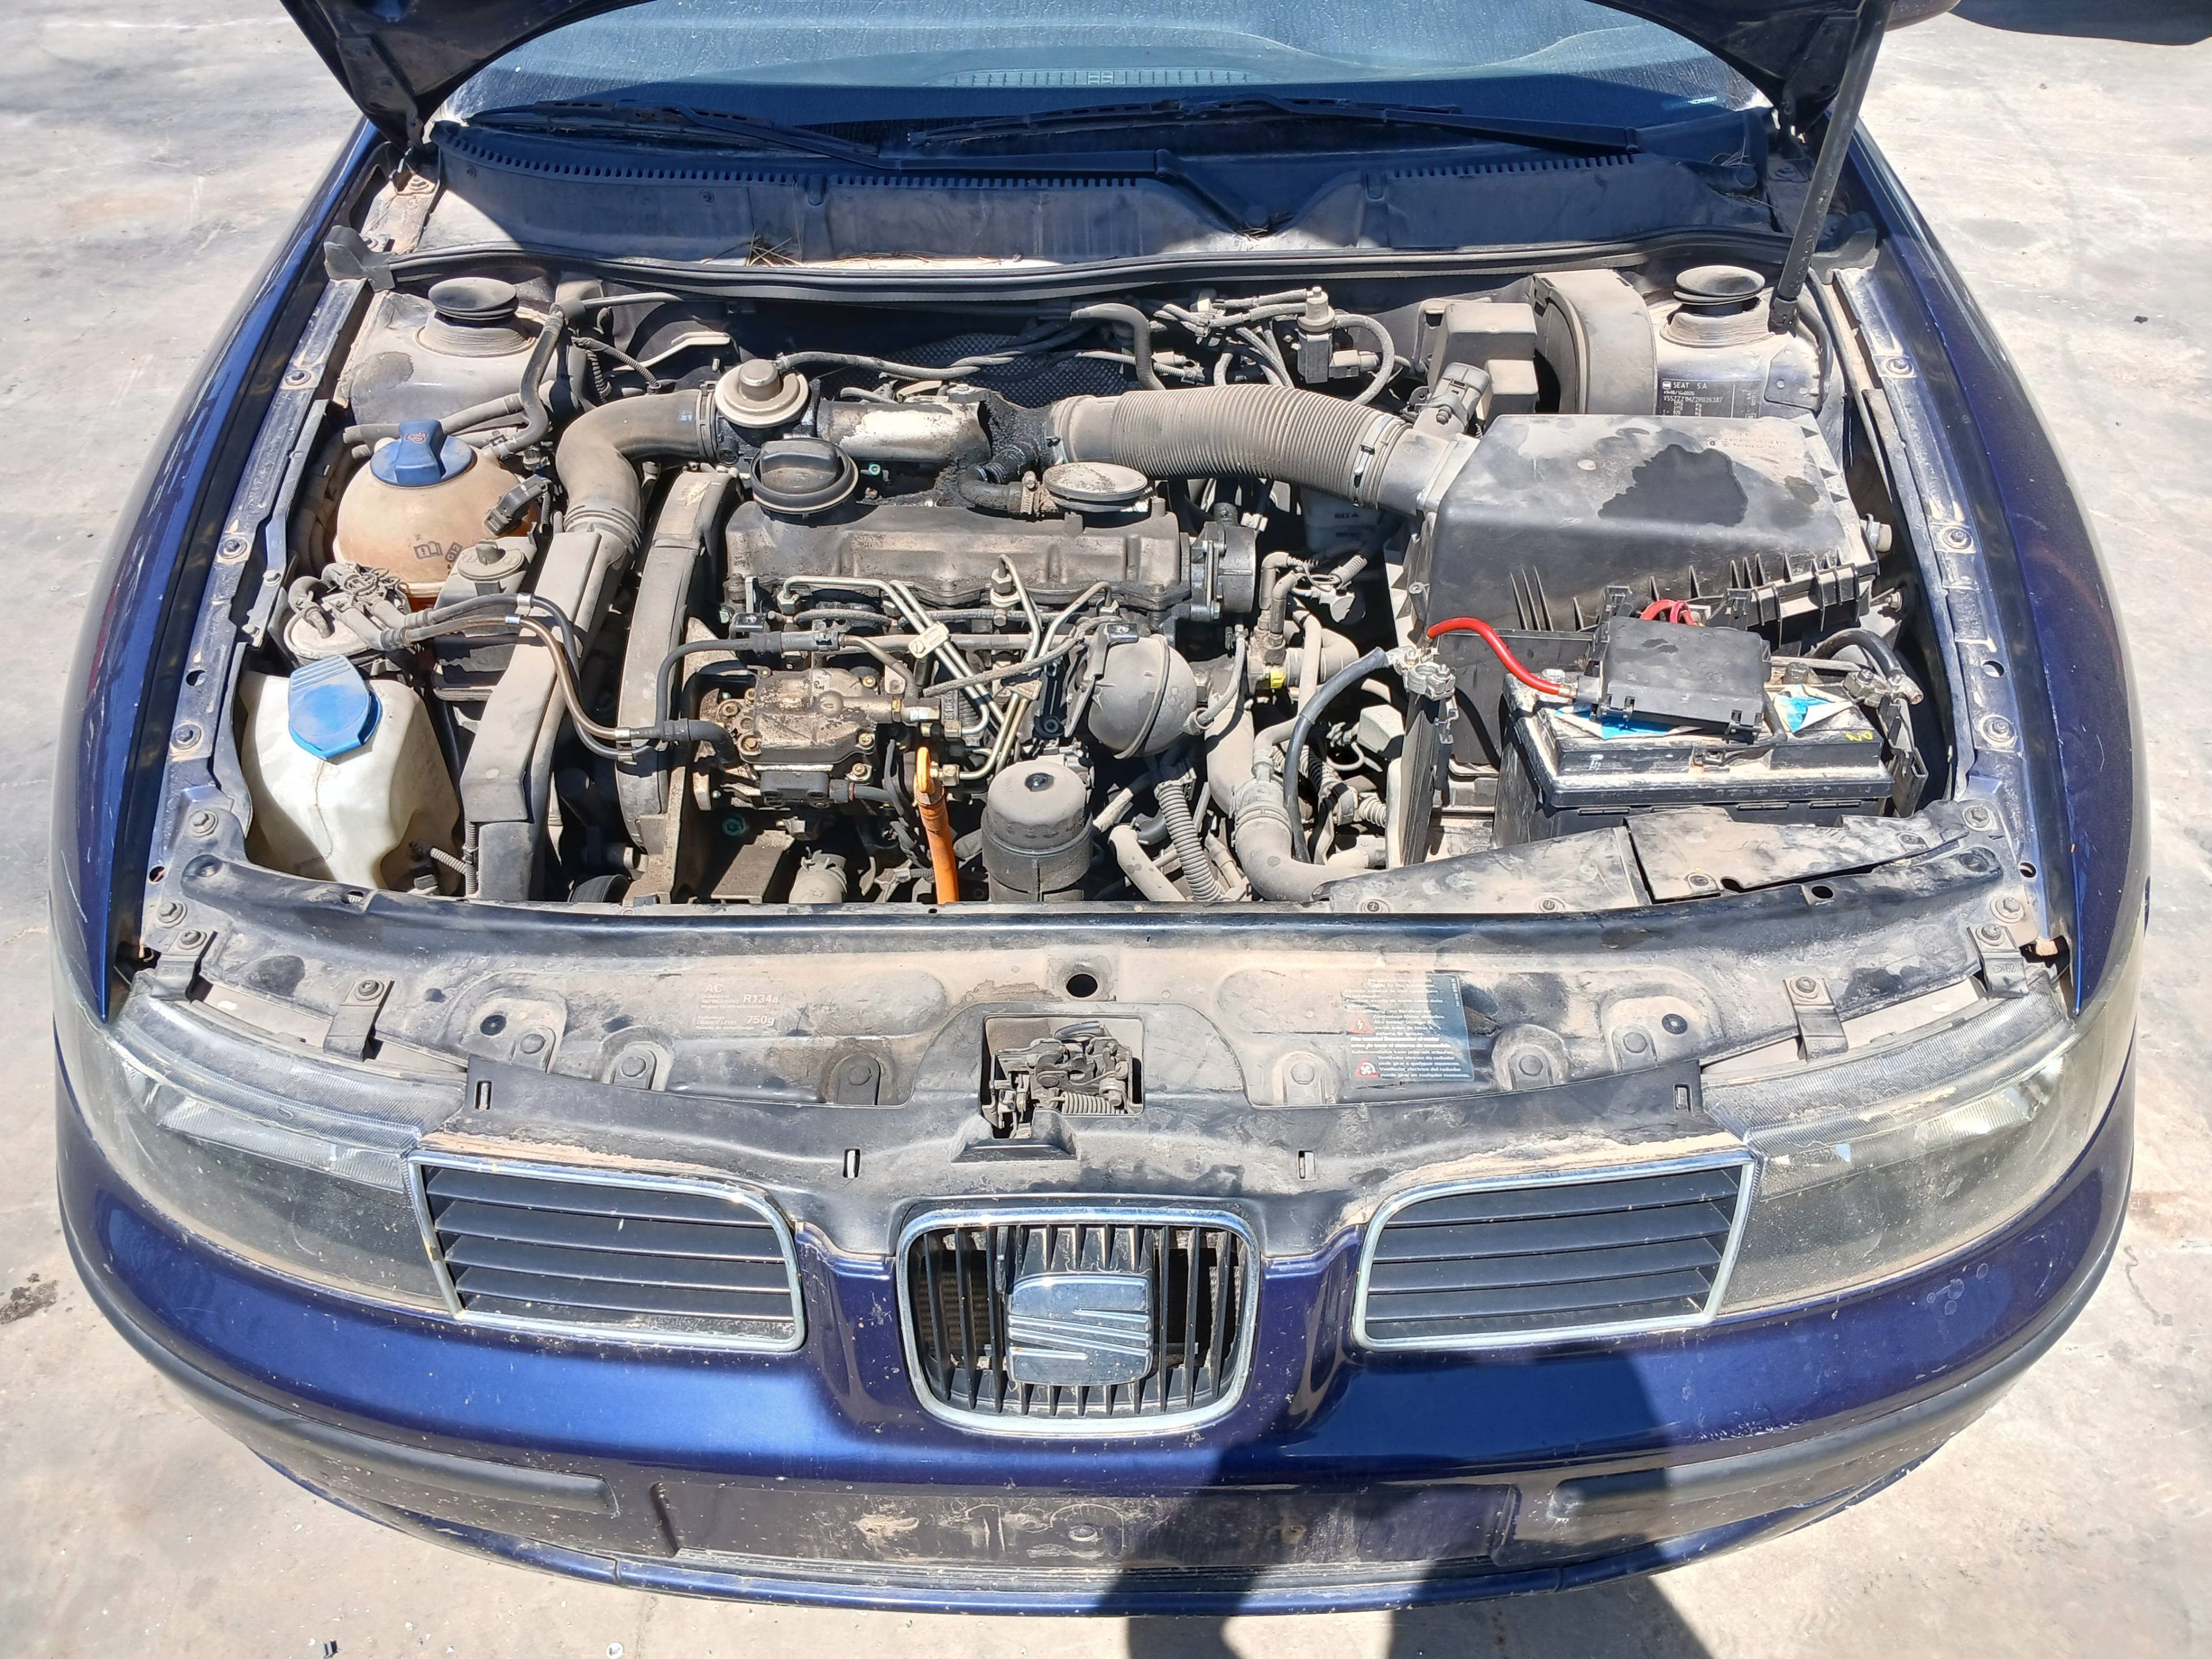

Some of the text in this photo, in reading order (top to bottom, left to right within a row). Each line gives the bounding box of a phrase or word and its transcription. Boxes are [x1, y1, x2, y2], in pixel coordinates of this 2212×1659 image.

[447, 545, 460, 560] G12
[704, 984, 724, 993] AC
[743, 994, 779, 1003] R134a
[747, 1015, 775, 1027] 750g
